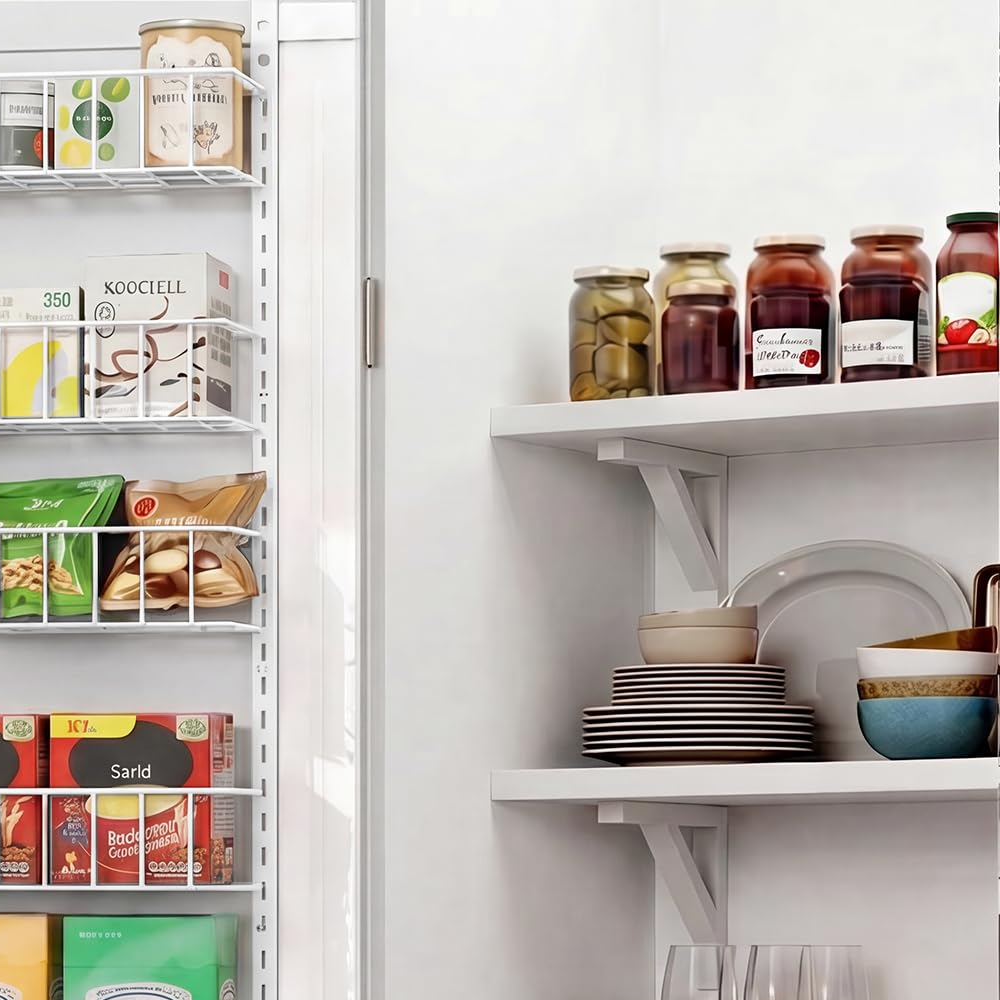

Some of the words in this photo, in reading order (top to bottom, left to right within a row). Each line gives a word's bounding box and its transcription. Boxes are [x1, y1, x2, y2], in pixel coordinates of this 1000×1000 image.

[104, 280, 187, 295] KOOCIELL
[43, 292, 71, 308] 350
[111, 764, 151, 779] Sarld
